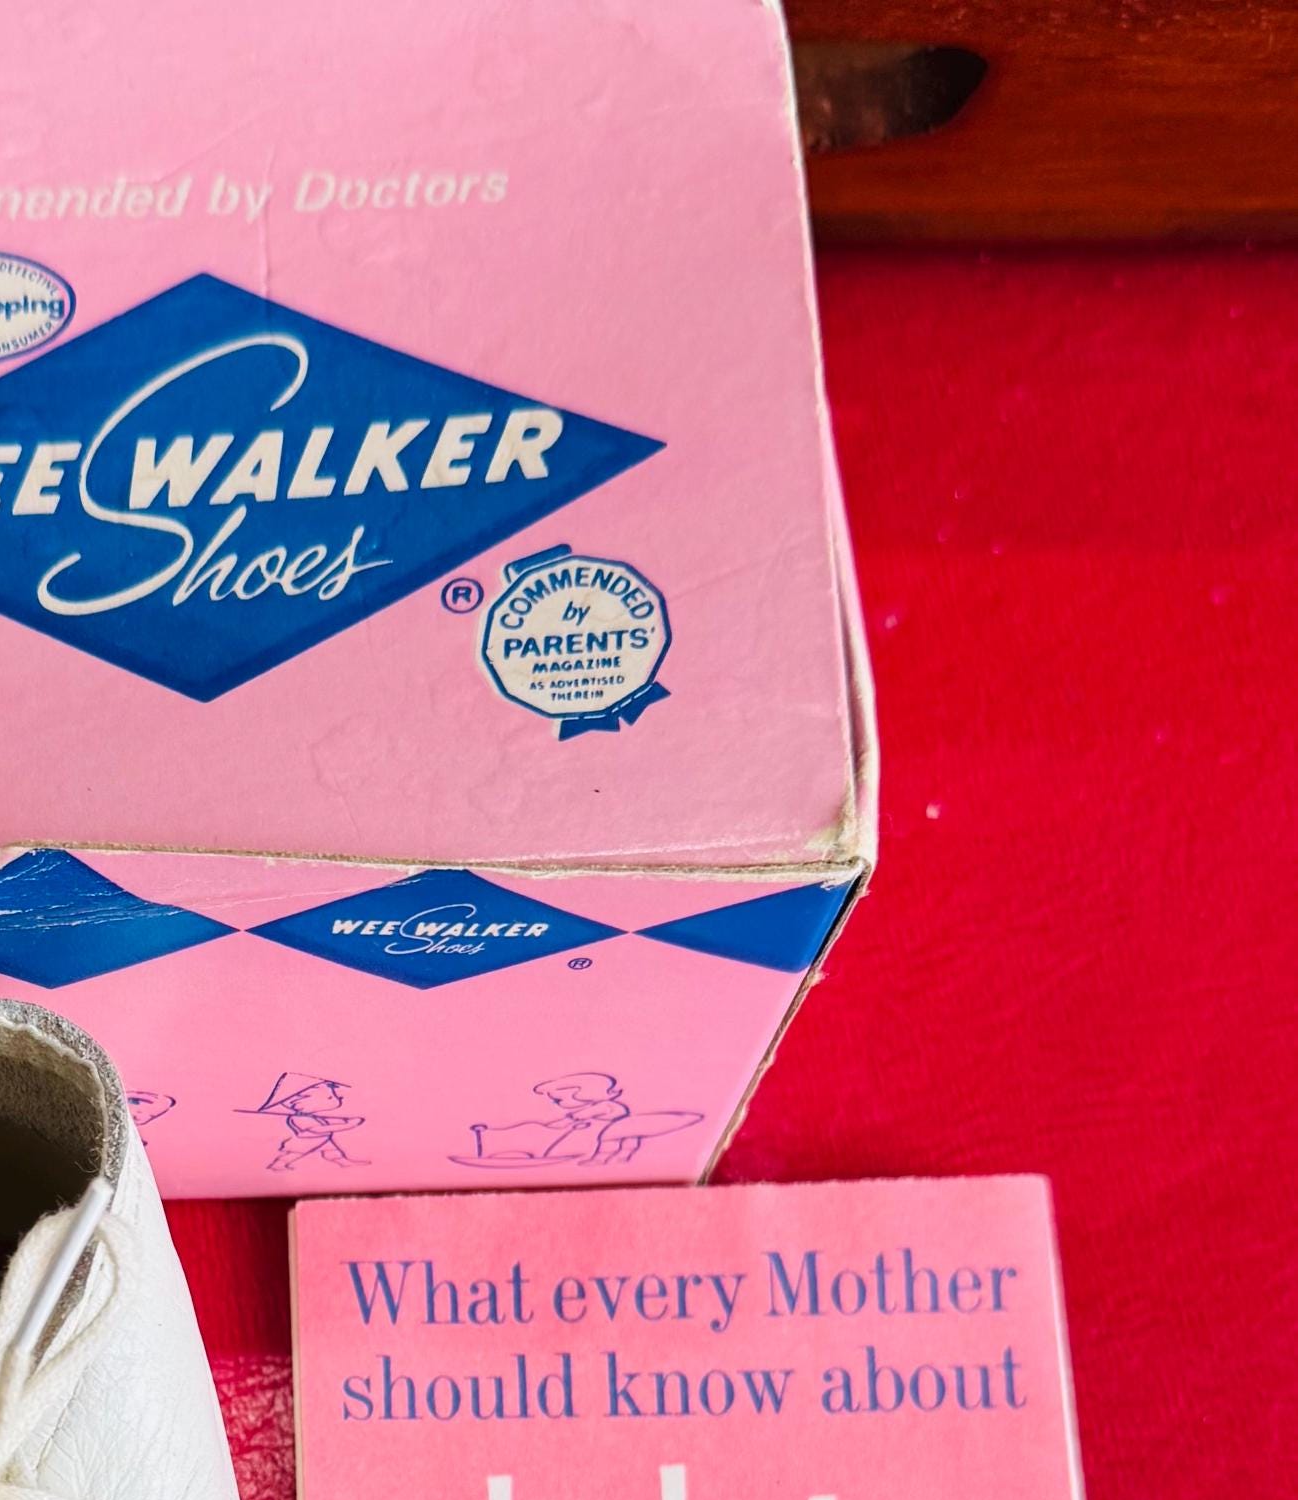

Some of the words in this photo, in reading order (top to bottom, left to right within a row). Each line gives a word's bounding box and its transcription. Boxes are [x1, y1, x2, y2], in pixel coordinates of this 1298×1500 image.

[207, 174, 271, 224] by
[294, 171, 509, 212] Doctors
[0, 262, 58, 296] DEFECTIVE
[38, 333, 392, 616] Shoes
[128, 408, 563, 509] WALKER
[500, 567, 655, 630] COMMENDED
[562, 601, 590, 625] by
[529, 681, 544, 690] AS
[550, 675, 625, 689] ADVERTISED
[532, 656, 621, 674] MAGAZINE
[551, 690, 604, 701] THEREIN
[331, 920, 402, 935] WEE
[414, 921, 549, 937] WALKER
[384, 903, 485, 954] Shoes
[340, 1259, 534, 1325] What
[553, 1272, 748, 1333] every
[763, 1247, 1018, 1317] Mother
[341, 1352, 580, 1421] should
[601, 1351, 796, 1417] know
[820, 1346, 1027, 1413] about
